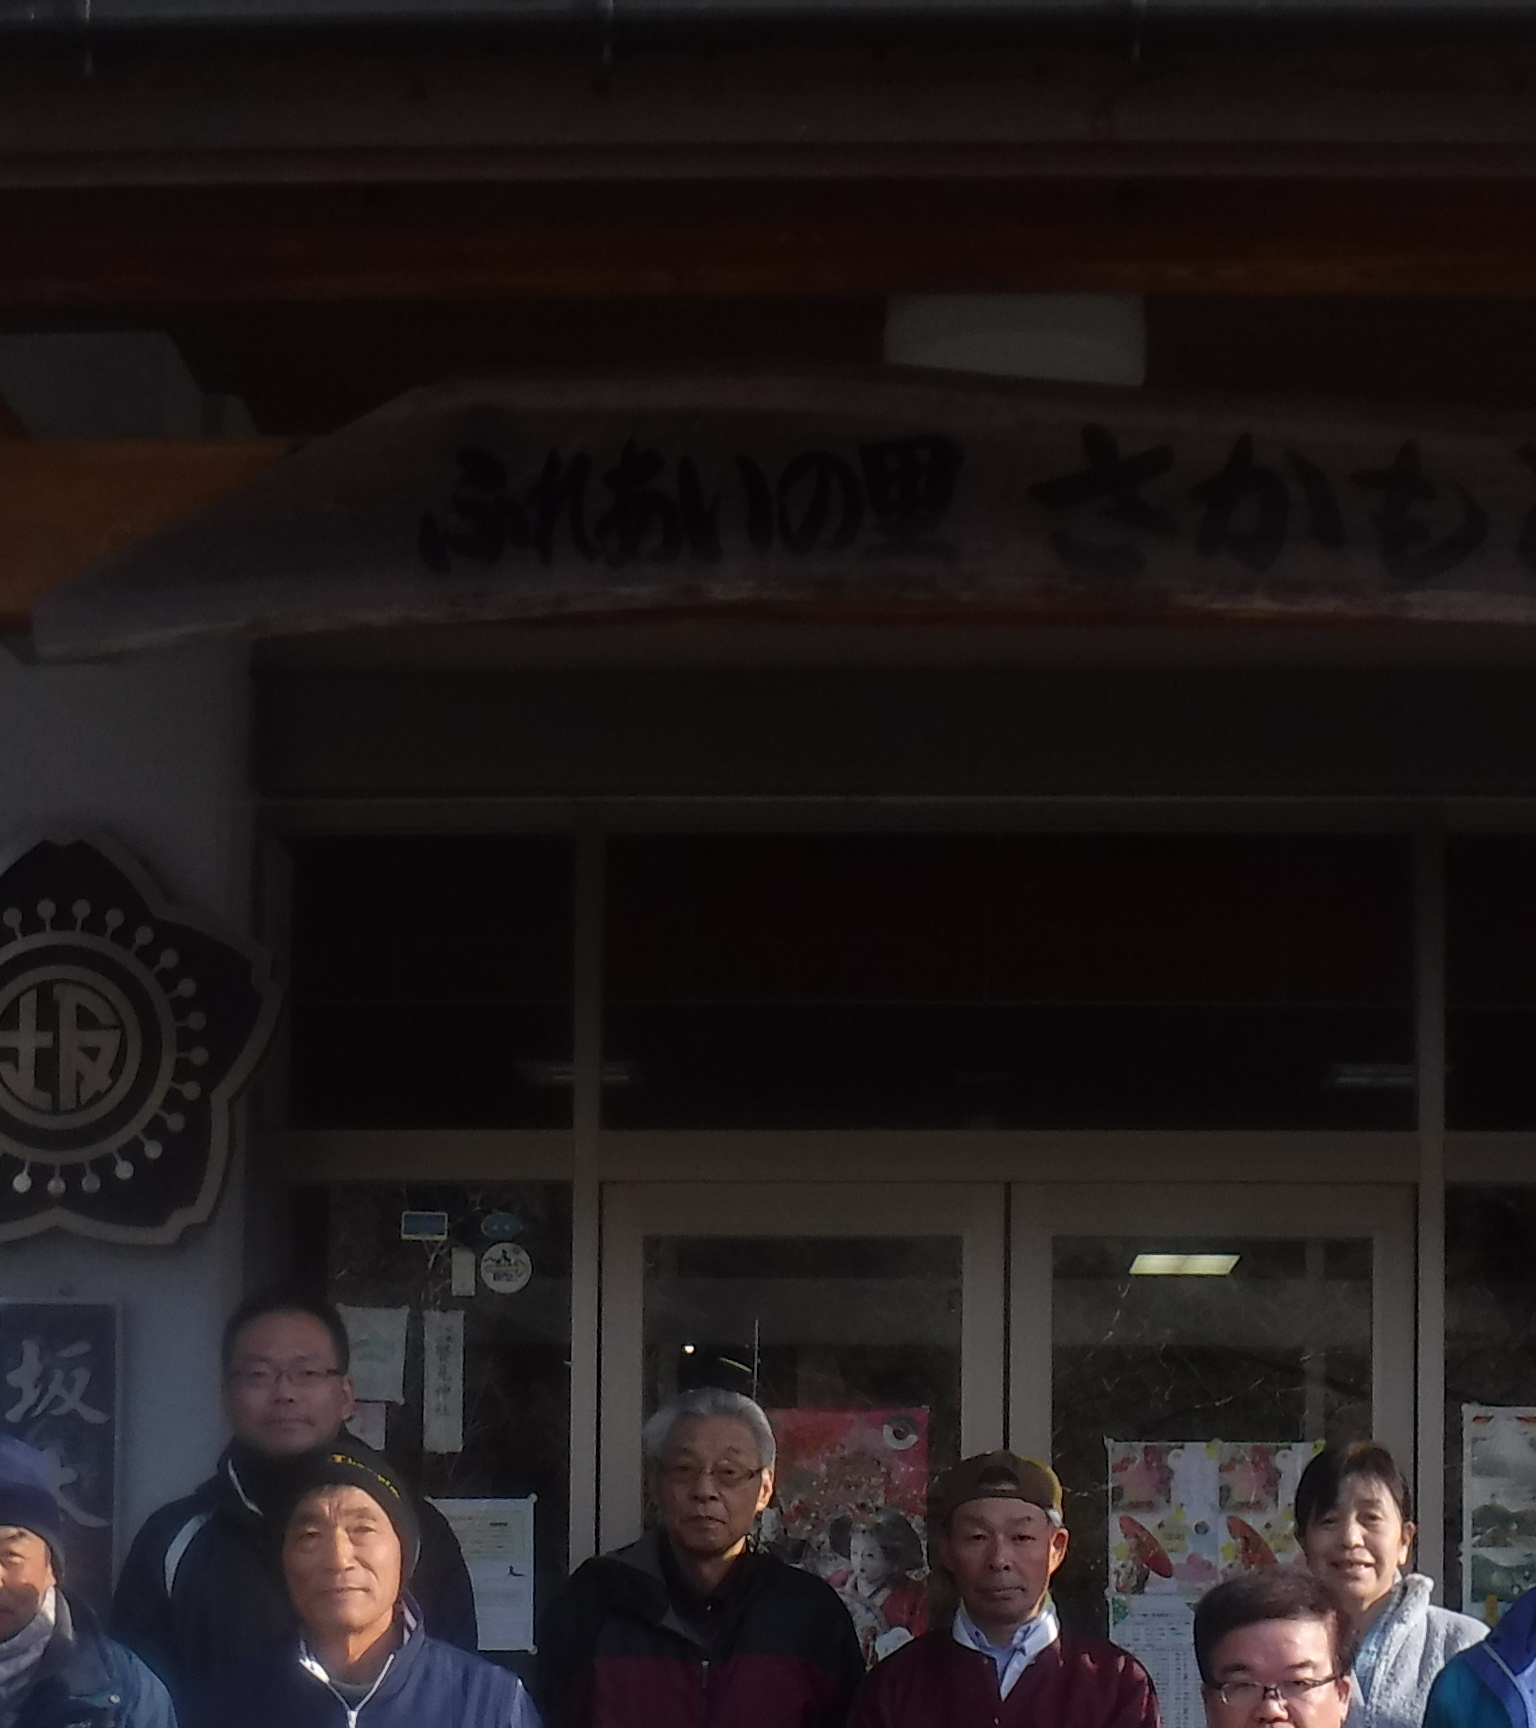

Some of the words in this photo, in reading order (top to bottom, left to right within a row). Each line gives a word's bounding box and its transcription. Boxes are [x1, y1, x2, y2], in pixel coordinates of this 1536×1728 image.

[418, 434, 964, 572] ふれあいの里
